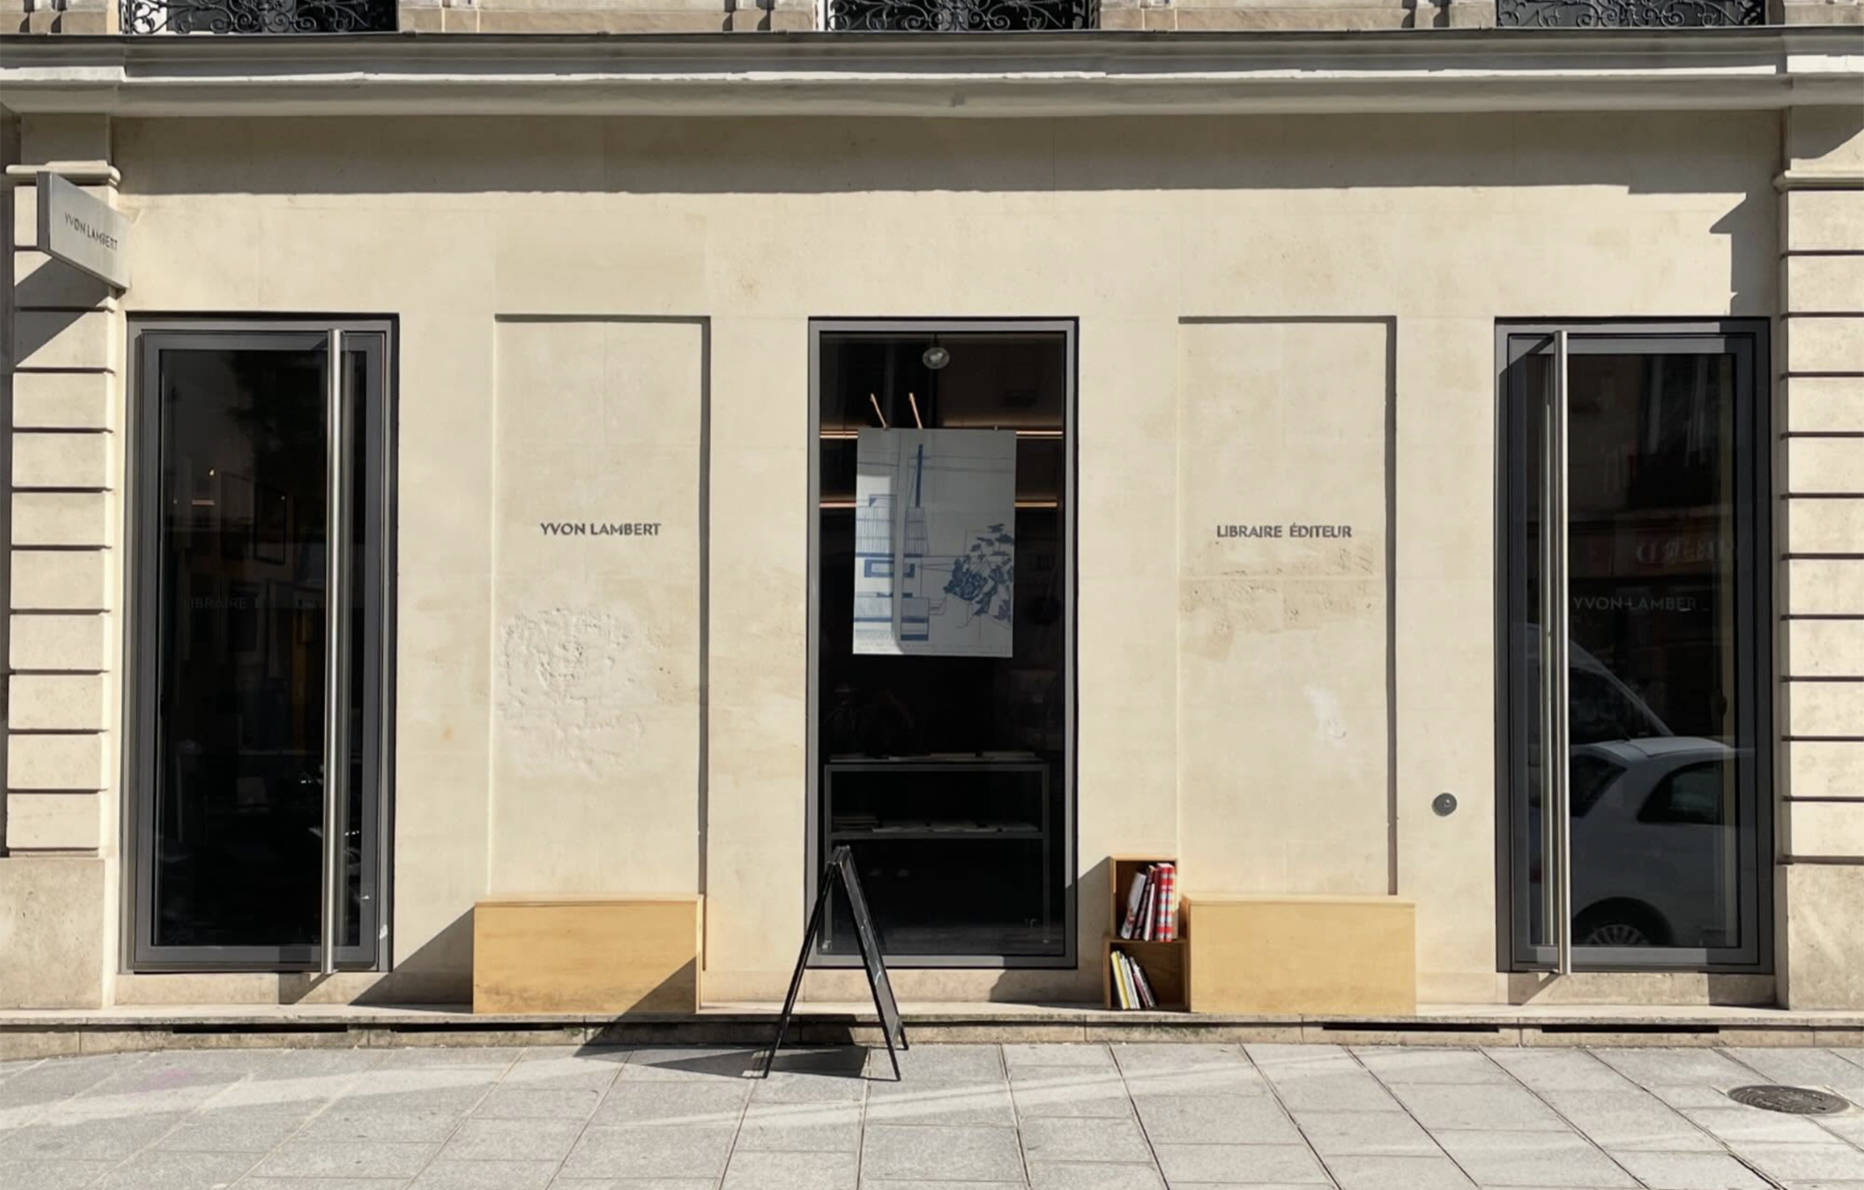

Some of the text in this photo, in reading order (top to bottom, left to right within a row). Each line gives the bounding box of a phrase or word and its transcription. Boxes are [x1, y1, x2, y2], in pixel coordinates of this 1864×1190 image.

[65, 211, 118, 251] YVON LAMBERT
[540, 522, 661, 536] YVON LAMBERT
[1216, 522, 1352, 538] LIBRAIRE ÉDITEUR
[1572, 596, 1699, 610] YVON LAMBER
